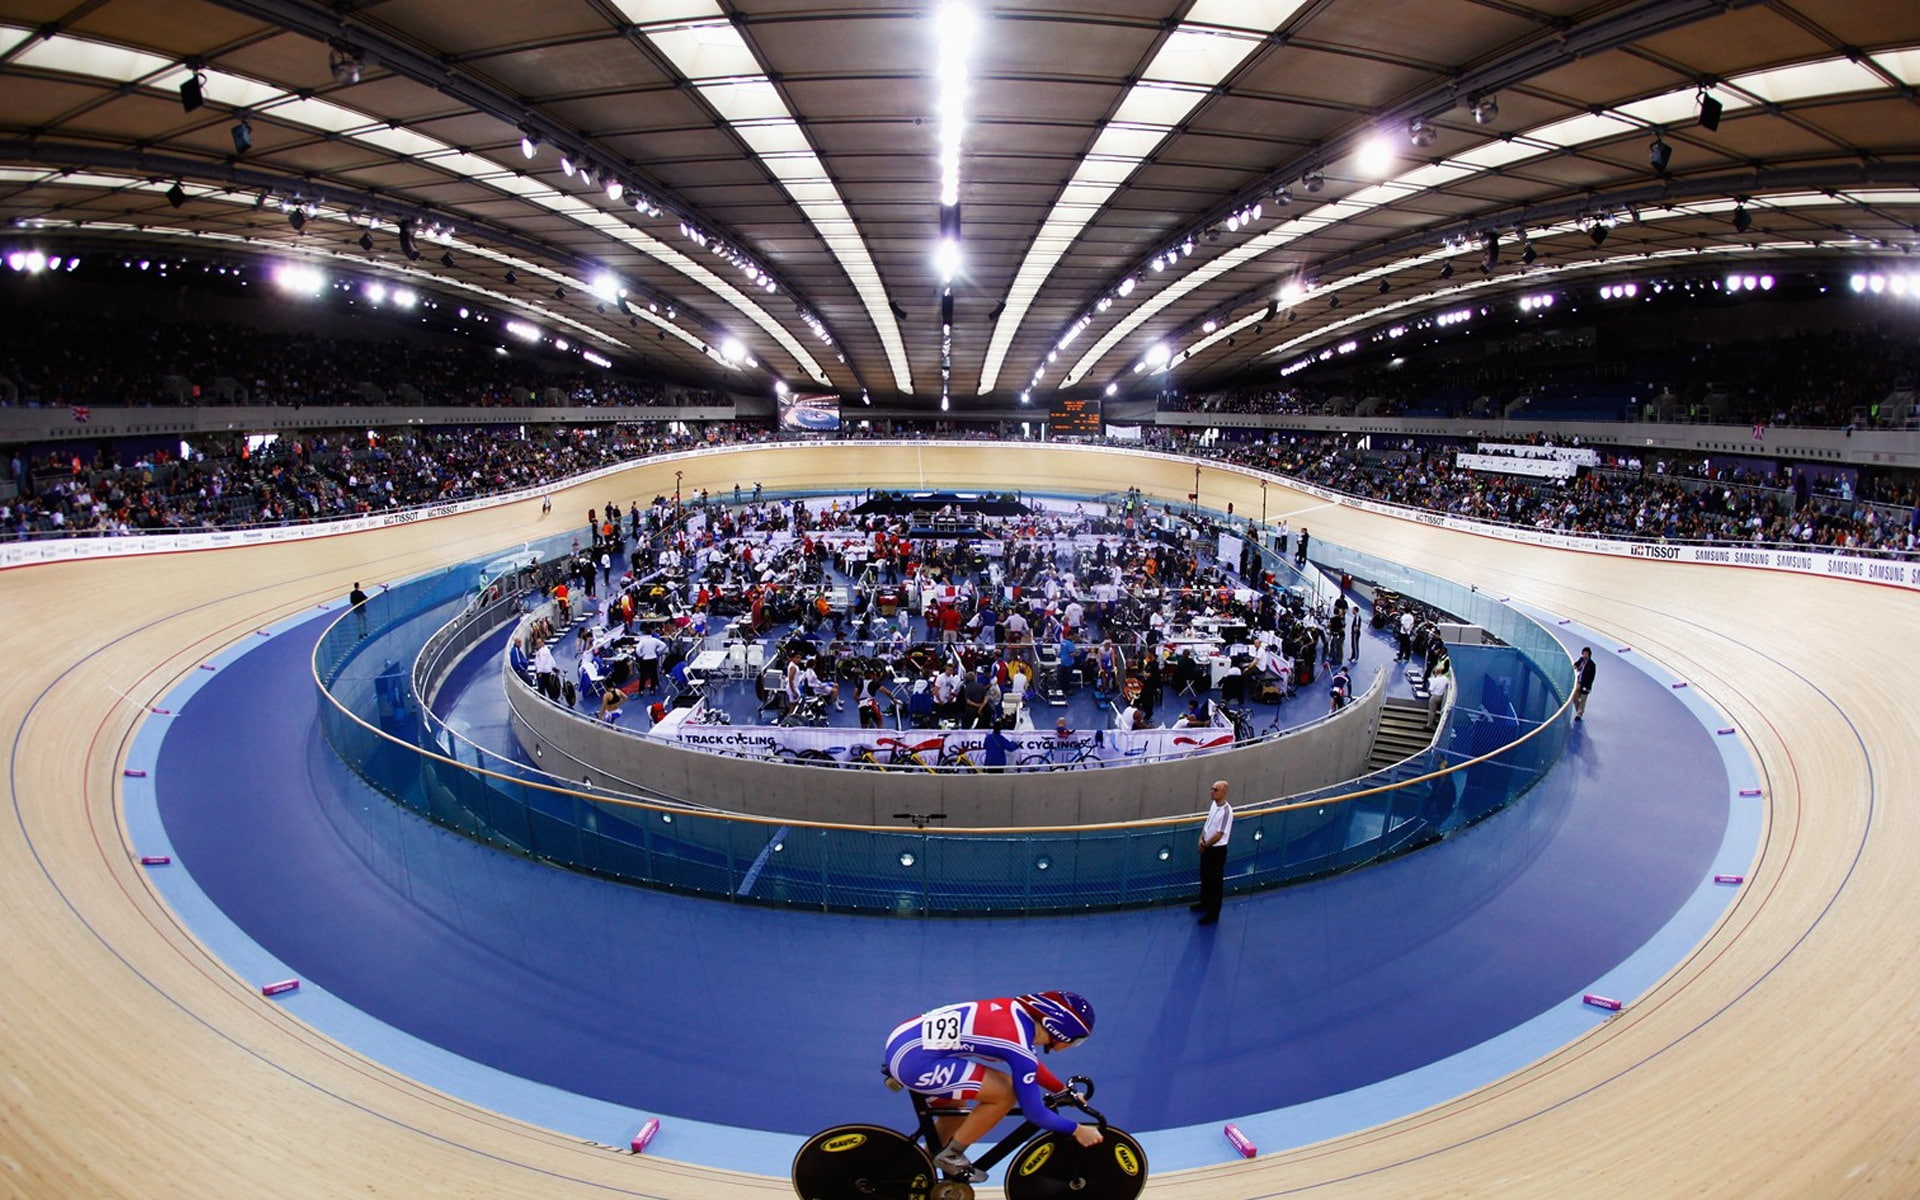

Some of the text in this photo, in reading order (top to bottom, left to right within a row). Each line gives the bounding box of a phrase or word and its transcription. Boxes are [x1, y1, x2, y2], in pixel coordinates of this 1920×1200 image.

[394, 511, 419, 523] TISSOT
[1424, 515, 1445, 526] TISSOT
[1645, 545, 1680, 559] TISSOT
[1695, 550, 1730, 562] SAMSUNG
[1735, 552, 1770, 565] SAMSUNG
[1777, 555, 1812, 570] SAMSUNG
[1828, 560, 1863, 576] SAMSUNG
[1869, 564, 1905, 582] SAMSUNG
[685, 735, 724, 745] TRACK
[726, 735, 776, 745] CYCLING
[926, 1017, 958, 1040] 193
[914, 1062, 956, 1087] sky
